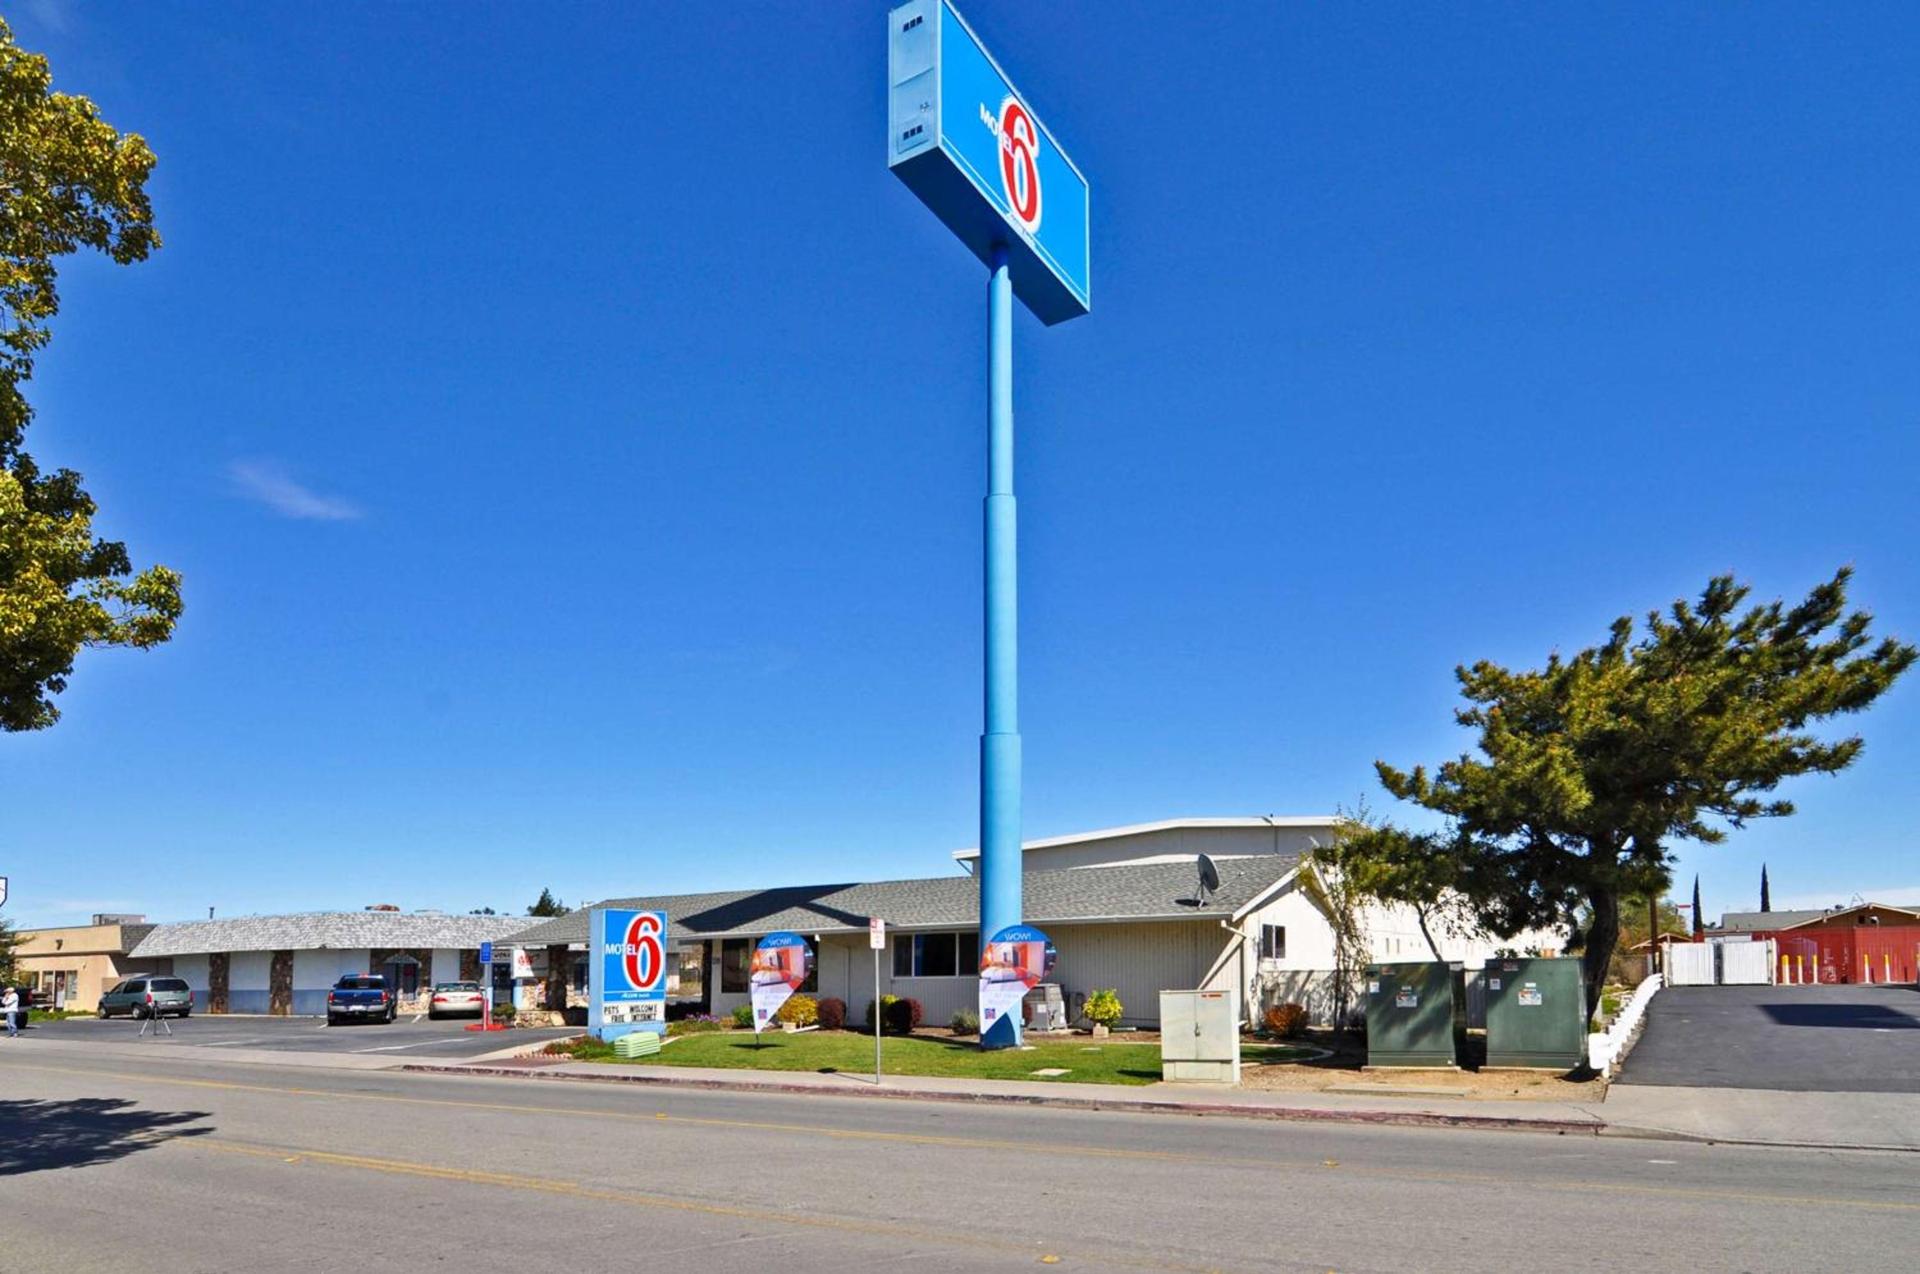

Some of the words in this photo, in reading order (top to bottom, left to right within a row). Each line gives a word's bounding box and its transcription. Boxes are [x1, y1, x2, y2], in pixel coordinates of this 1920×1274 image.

[1000, 100, 1038, 226] 6
[605, 943, 638, 956] MOTEL
[625, 914, 661, 989] 6
